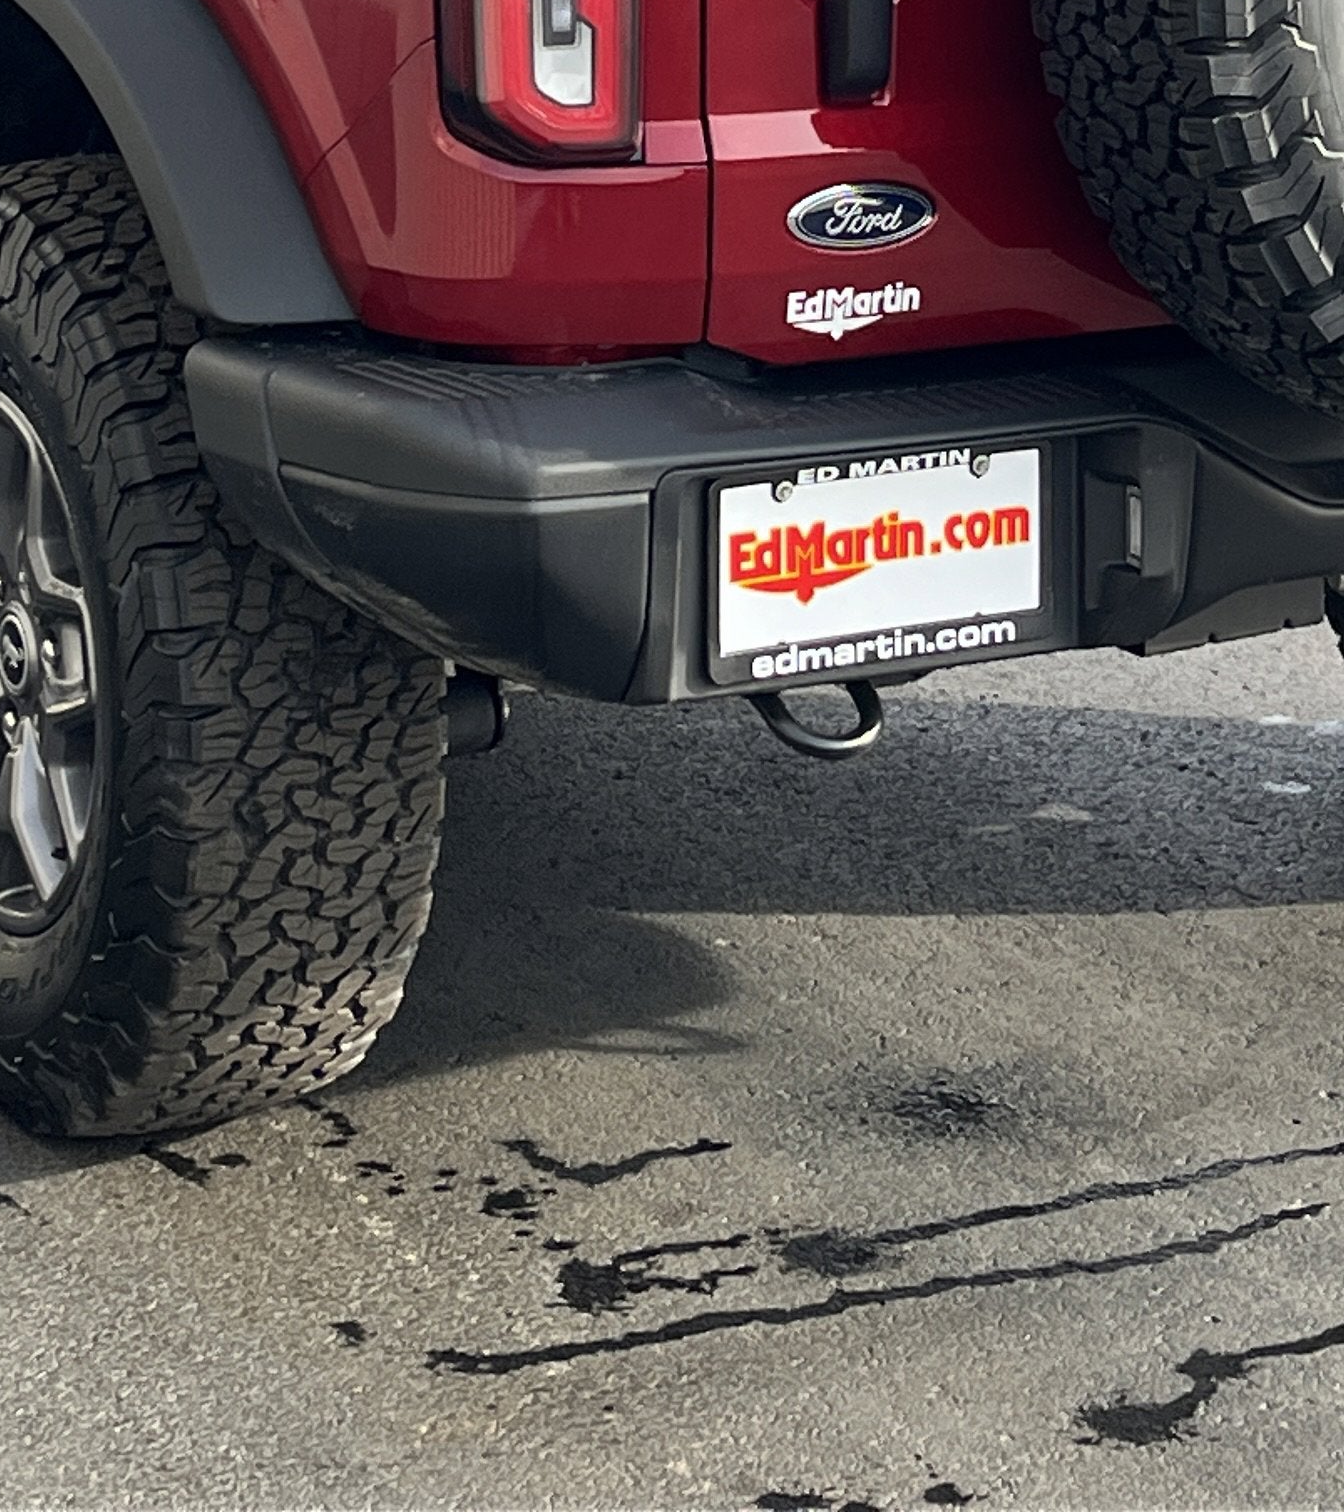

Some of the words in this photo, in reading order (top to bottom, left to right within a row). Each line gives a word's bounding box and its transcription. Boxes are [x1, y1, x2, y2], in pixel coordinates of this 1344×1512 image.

[825, 196, 904, 236] Ford
[786, 282, 921, 328] EdMartin
[797, 465, 841, 484] ED
[848, 447, 971, 479] MARTIN
[728, 506, 1031, 583] EdMartin.com
[751, 620, 1017, 679] edmartin.com
